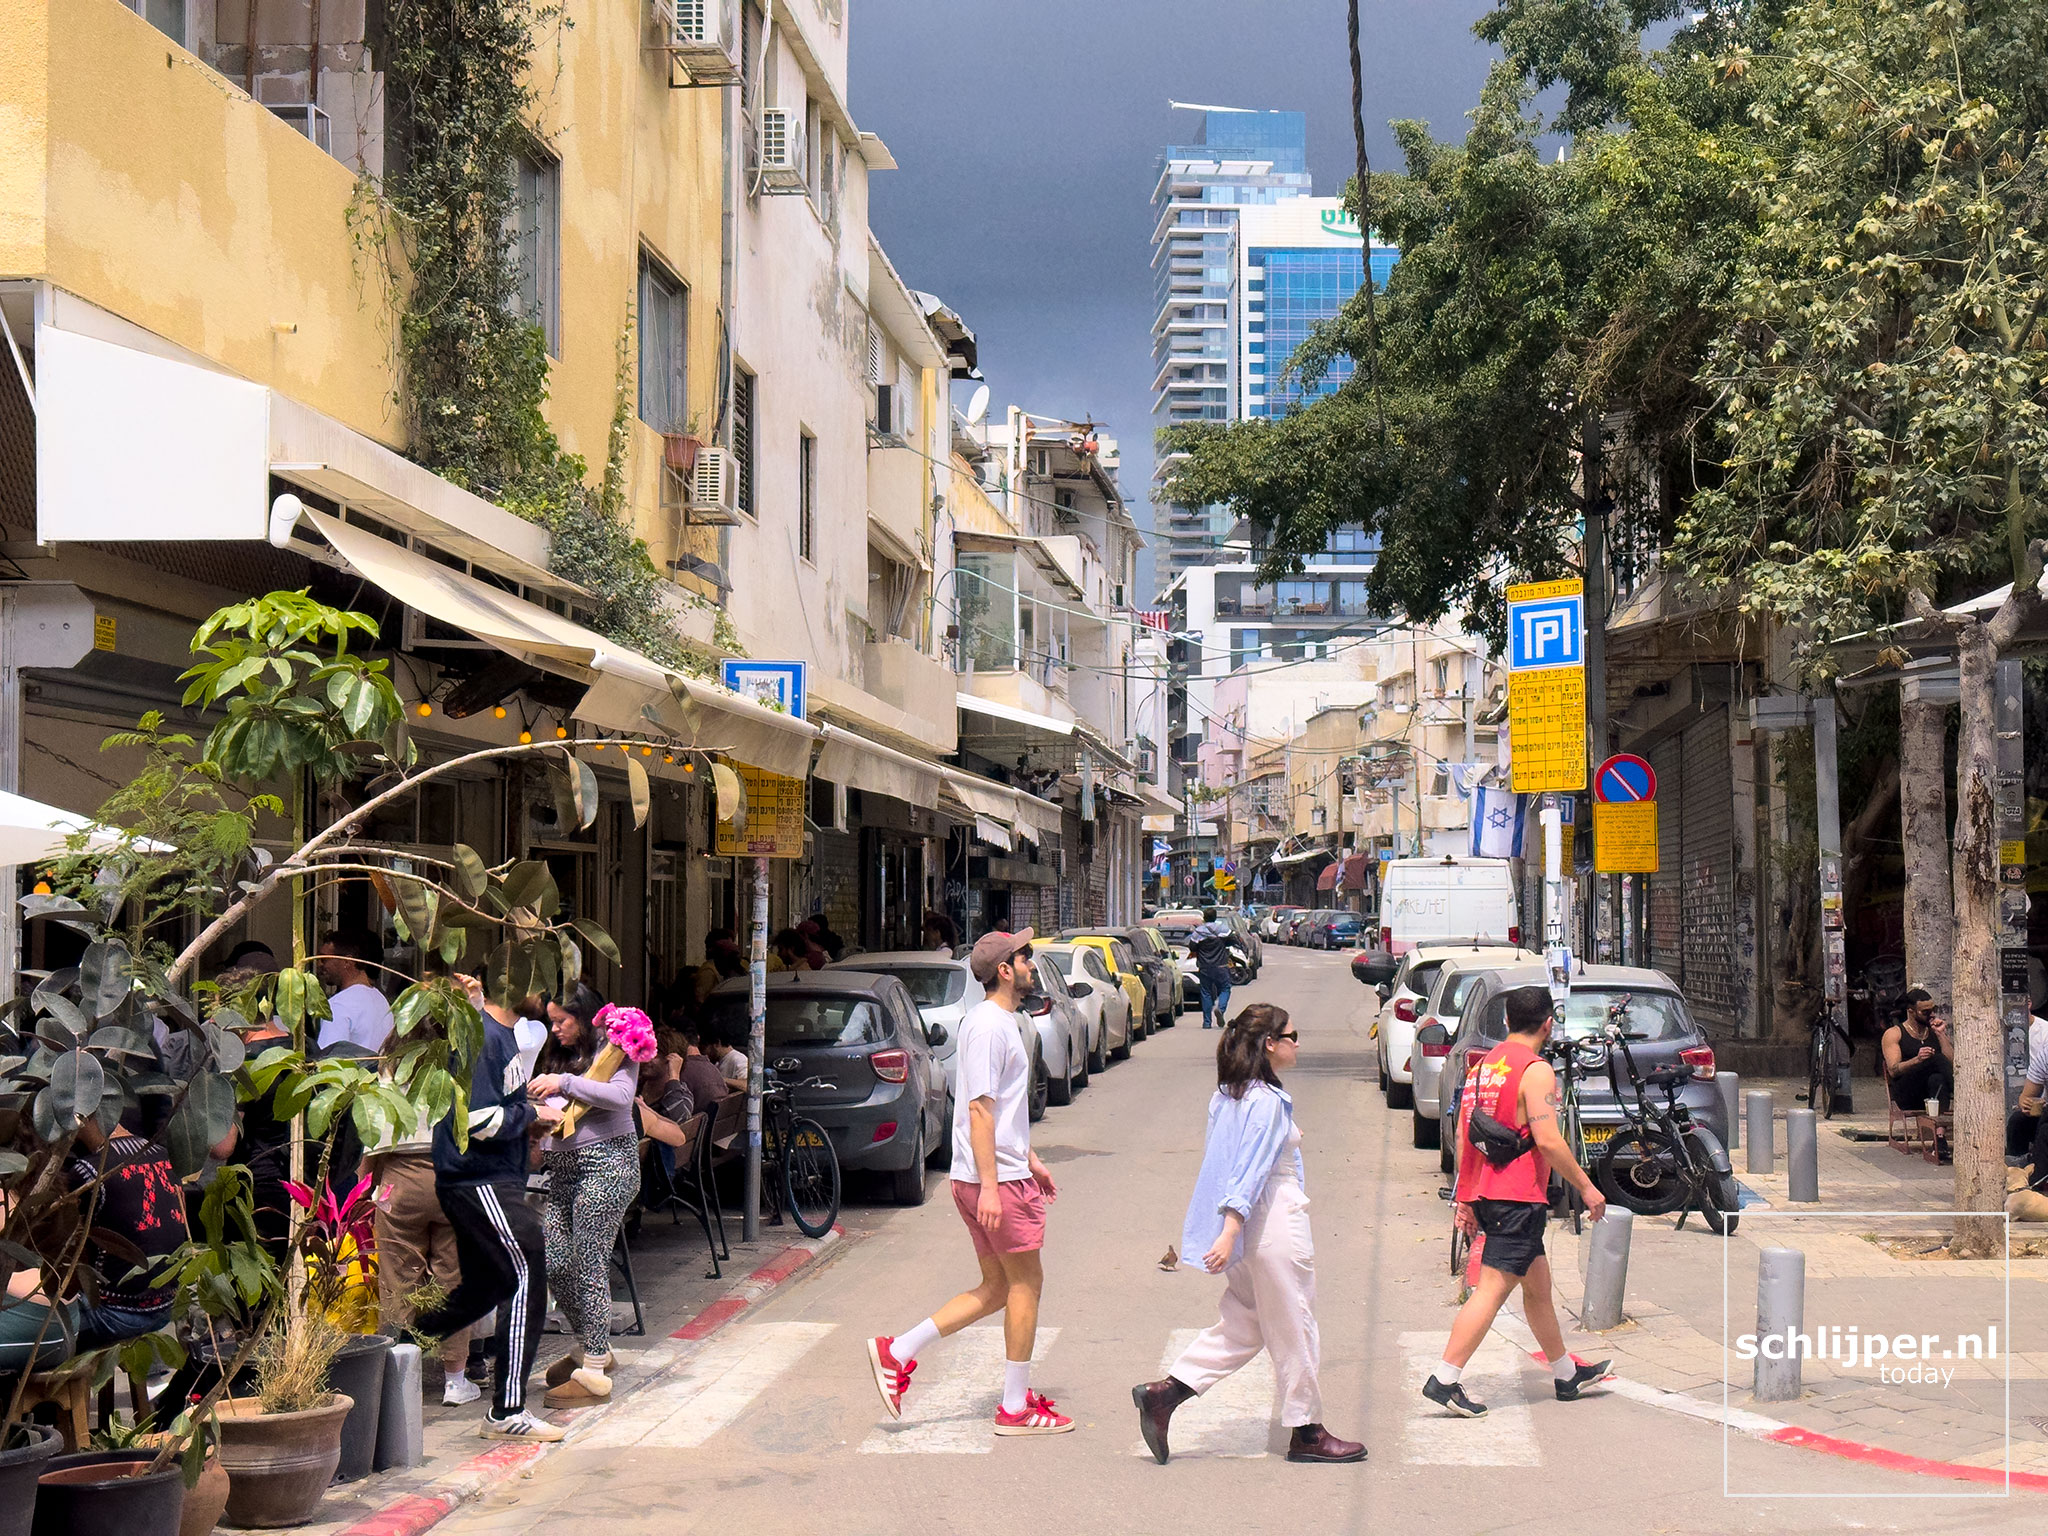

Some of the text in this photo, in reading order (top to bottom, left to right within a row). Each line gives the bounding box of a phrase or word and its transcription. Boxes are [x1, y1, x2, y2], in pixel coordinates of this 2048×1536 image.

[1537, 587, 1545, 595] זה
[1548, 585, 1561, 594] בצד
[1564, 583, 1580, 592] חניה
[1565, 683, 1579, 692] ימים
[760, 778, 776, 787] חינם
[760, 806, 776, 815] חינם
[759, 834, 775, 843] חינם
